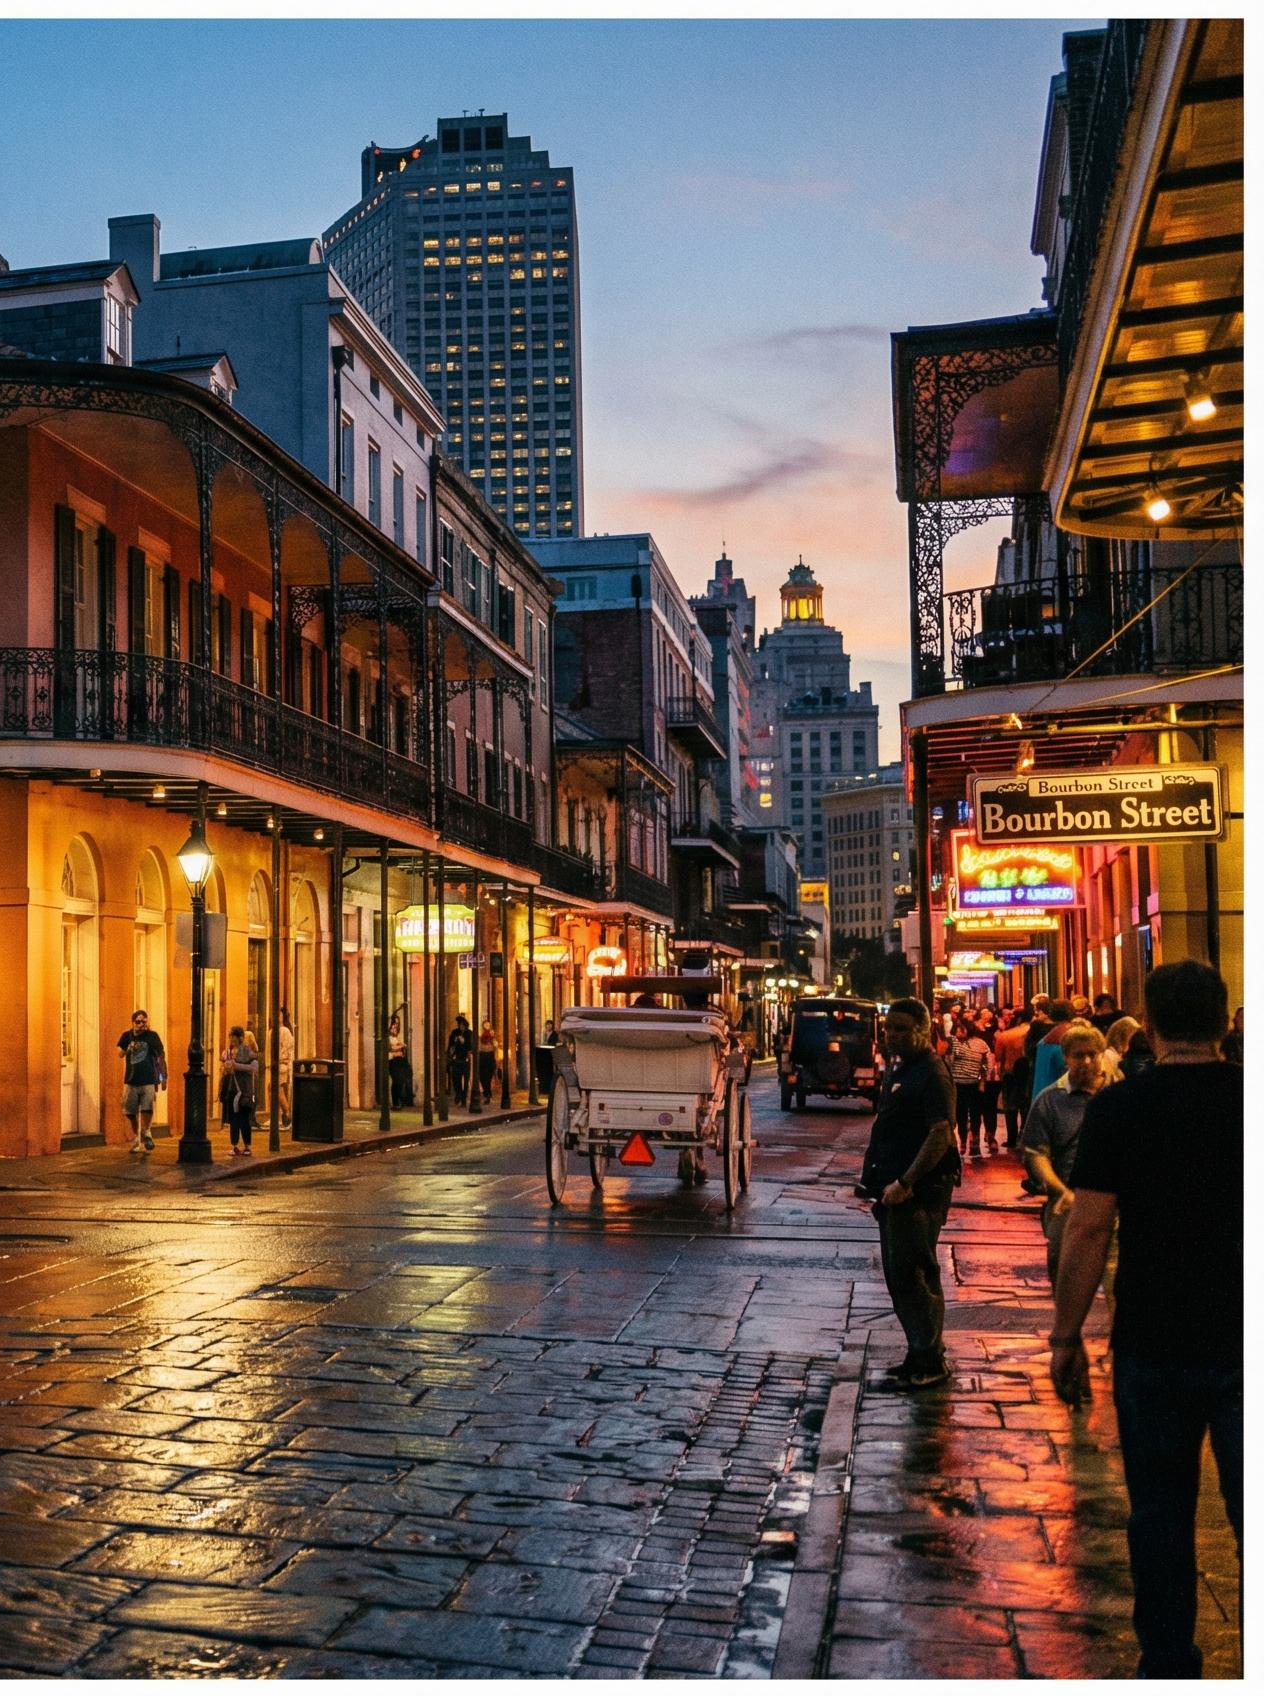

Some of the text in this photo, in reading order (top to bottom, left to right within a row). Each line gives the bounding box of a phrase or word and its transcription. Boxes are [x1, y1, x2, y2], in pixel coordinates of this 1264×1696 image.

[1038, 780, 1102, 795] Bourbon
[983, 797, 1212, 834] Bourbon Street
